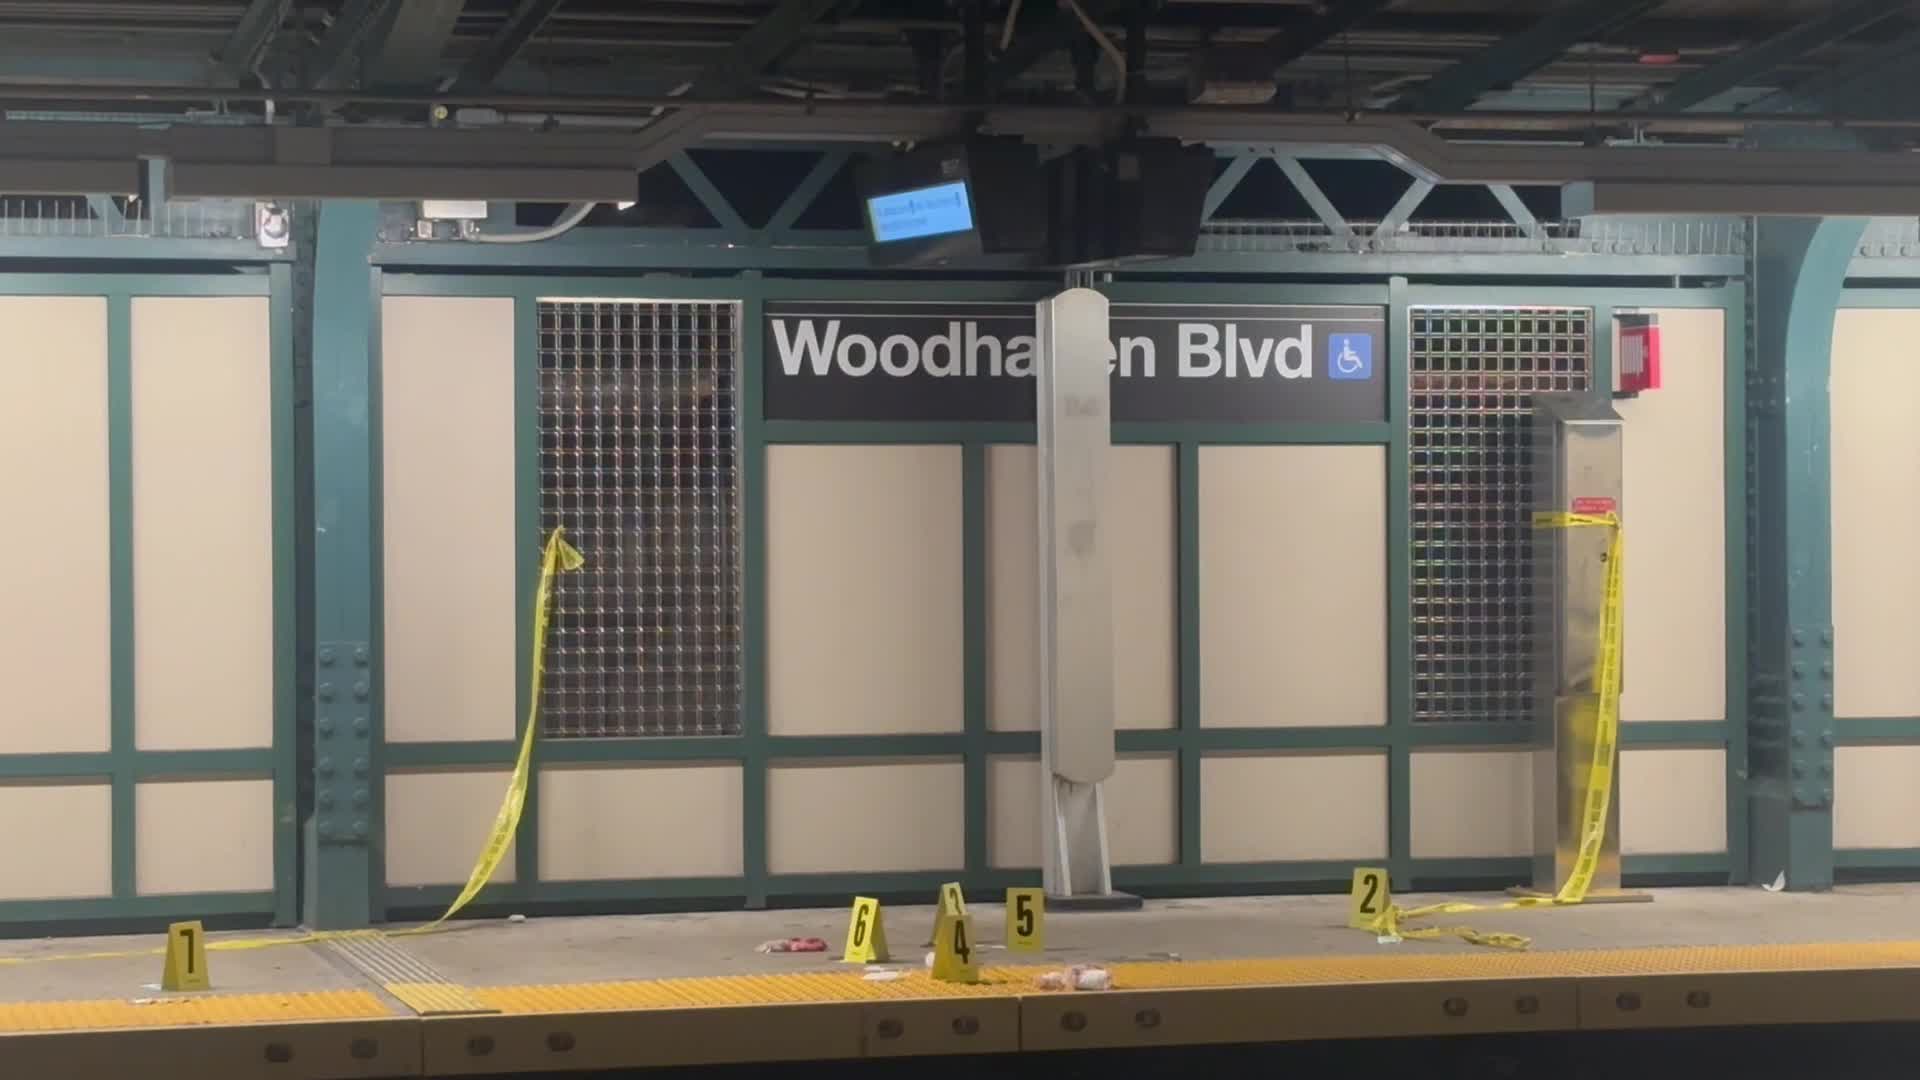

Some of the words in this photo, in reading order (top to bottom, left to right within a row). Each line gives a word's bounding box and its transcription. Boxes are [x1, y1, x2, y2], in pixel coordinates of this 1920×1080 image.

[771, 319, 1156, 378] Woodhan
[1178, 323, 1313, 379] Blvd
[1017, 894, 1034, 937] 5
[1360, 874, 1378, 914] 2
[853, 903, 869, 947] 6
[954, 919, 970, 964] 4
